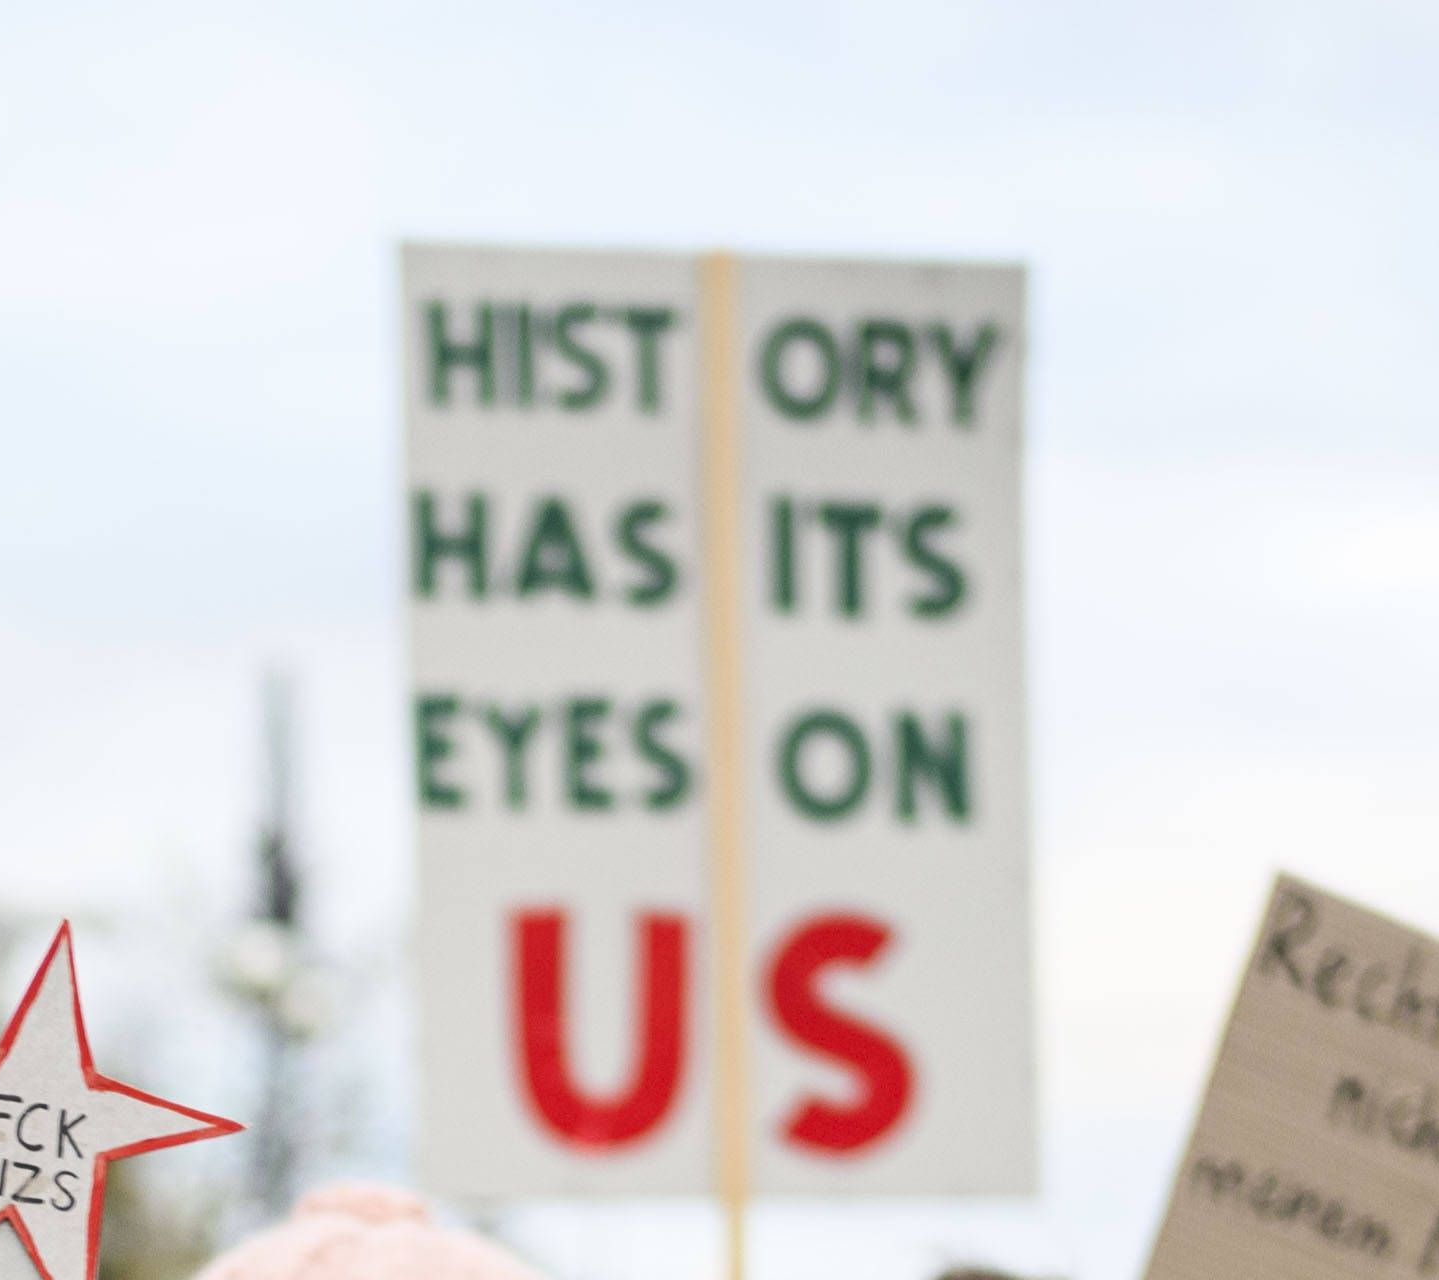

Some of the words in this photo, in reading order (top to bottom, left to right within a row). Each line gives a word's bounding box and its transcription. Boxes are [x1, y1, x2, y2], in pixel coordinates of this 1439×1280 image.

[412, 487, 681, 605] HAS
[770, 493, 972, 621] ITS
[414, 694, 693, 812] EYES
[774, 706, 975, 824] ON
